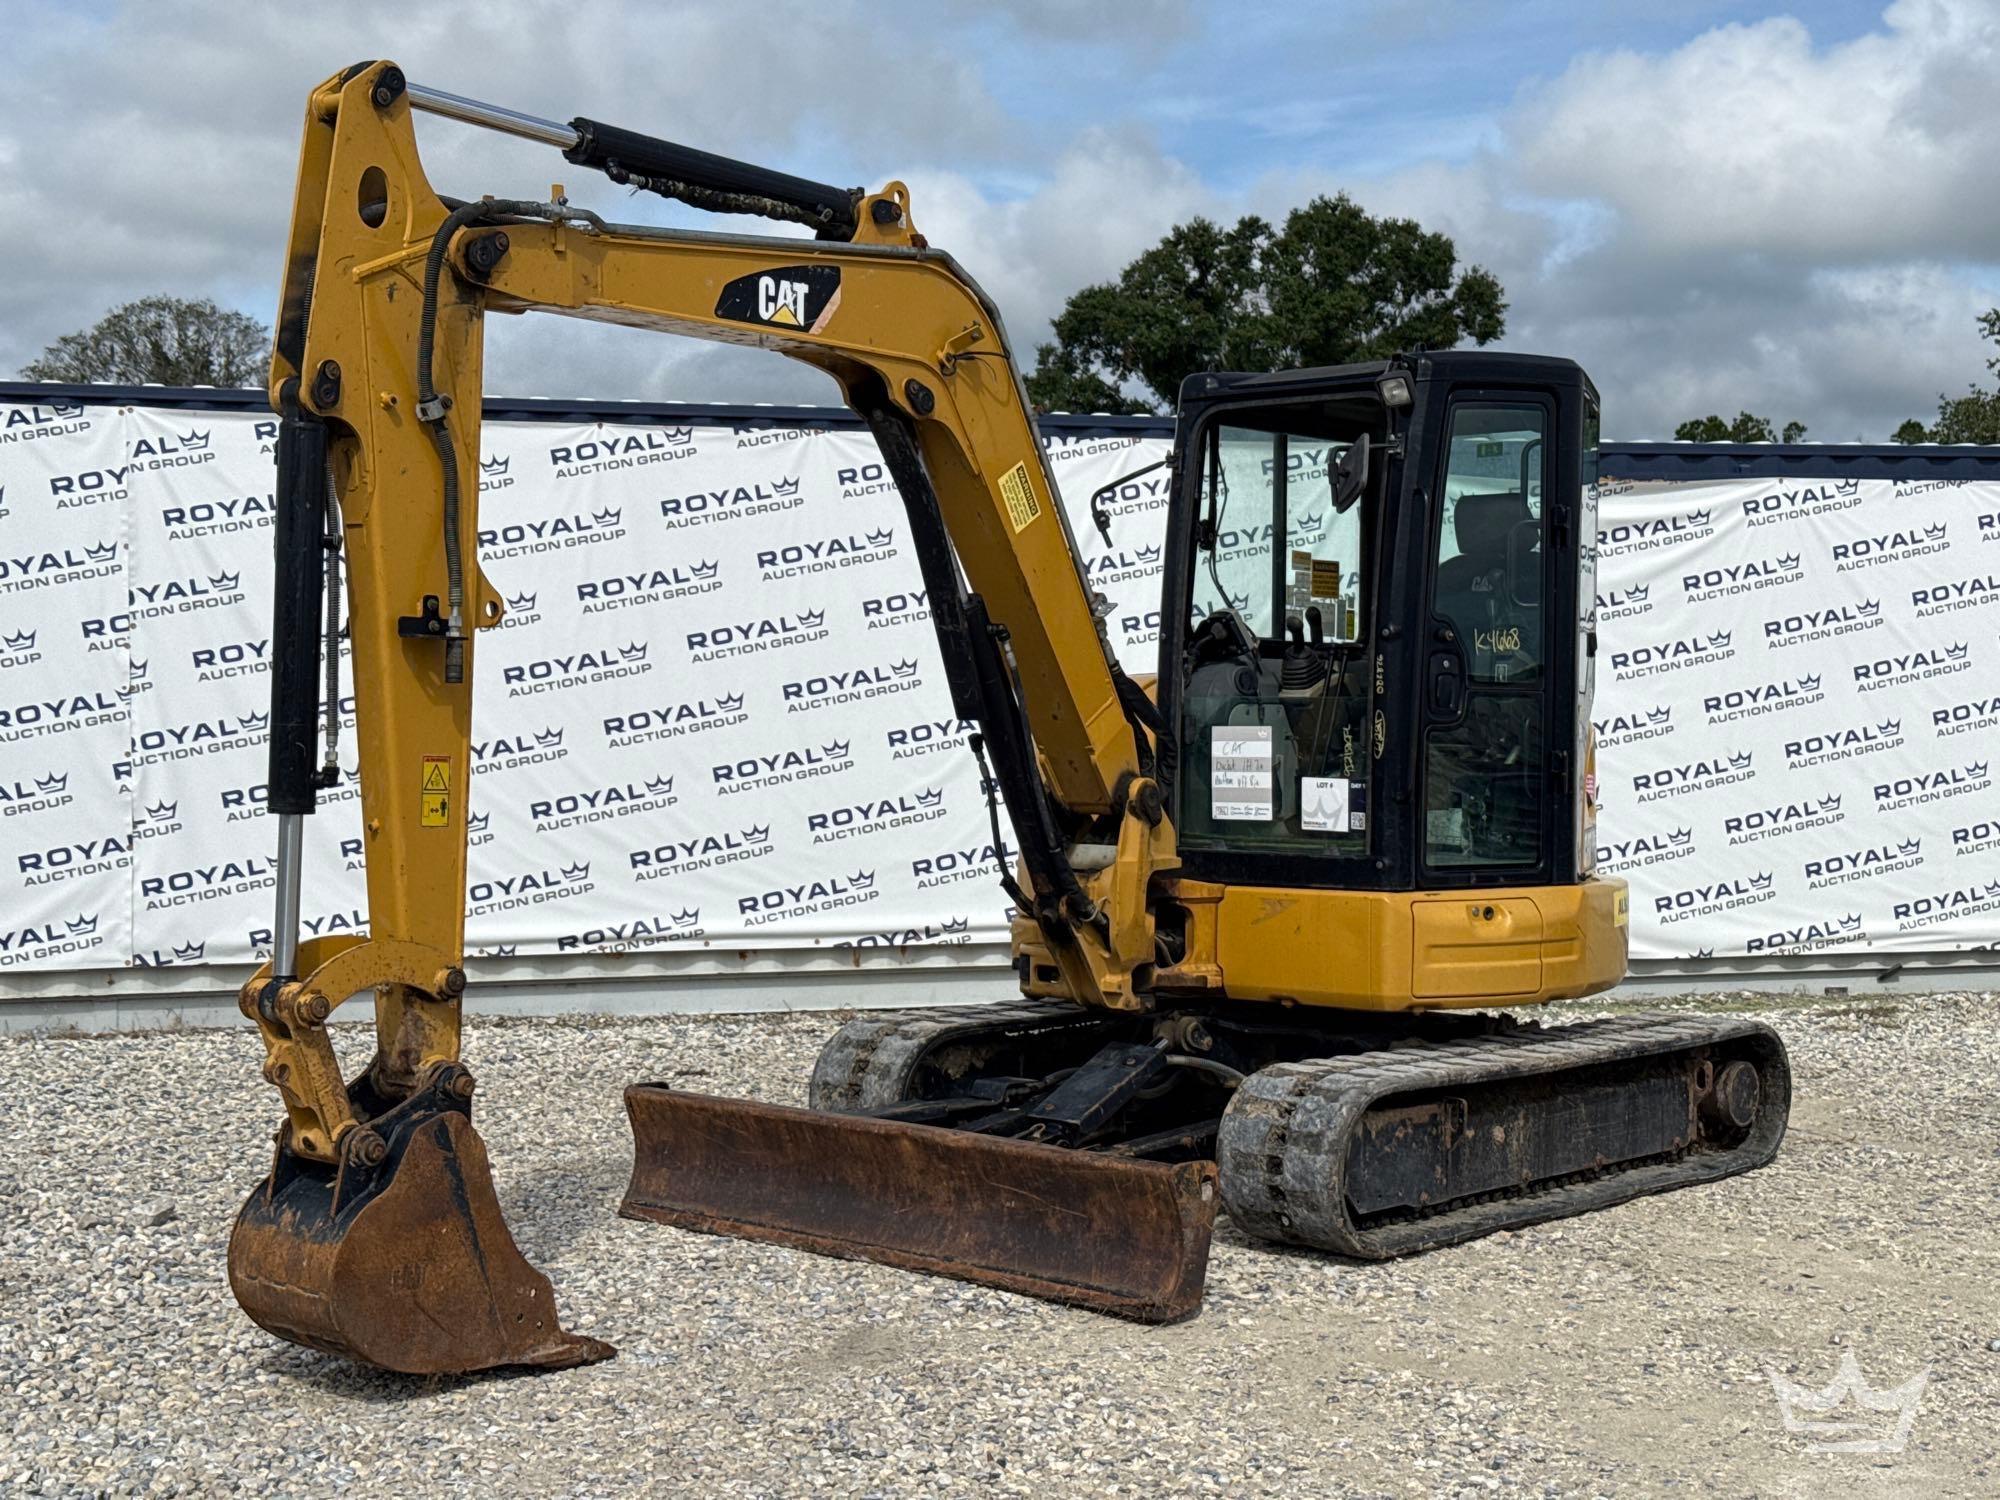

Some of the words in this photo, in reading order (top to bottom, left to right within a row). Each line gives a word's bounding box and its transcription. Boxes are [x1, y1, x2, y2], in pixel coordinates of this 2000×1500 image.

[758, 276, 808, 326] CAT
[22, 422, 90, 440] GROUP
[148, 453, 215, 470] GROUP
[550, 434, 664, 465] ROYAL
[556, 458, 633, 478] AUCTION
[637, 448, 697, 465] GROUP
[50, 466, 129, 495] ROY
[479, 478, 514, 492] OUP
[57, 490, 128, 509] AUCTIO
[661, 484, 772, 516] ROYAL
[666, 509, 741, 530] AUCTION
[745, 498, 804, 516] GROUP
[1742, 486, 1835, 516] ROYAL
[1748, 509, 1810, 528] AUCTION
[1812, 498, 1862, 514] GROUP
[169, 520, 253, 540] AUCTION
[478, 516, 593, 548] ROYAL
[482, 540, 560, 561] AUCTION
[564, 529, 625, 547] GROUP
[1663, 528, 1713, 545] GROUP
[1833, 530, 1924, 560] ROYAL
[757, 536, 866, 568] ROYAL
[763, 560, 836, 581] AUCTION
[840, 549, 897, 567] GROUP
[1082, 552, 1136, 574] YAL
[1837, 552, 1899, 572] AUCTION
[1902, 542, 1950, 558] GROUP
[54, 564, 122, 584] GROUP
[577, 568, 690, 601] ROYAL
[1683, 560, 1777, 592] ROYAL
[1688, 583, 1751, 603] AUCTION
[1754, 572, 1804, 589] GROUP
[583, 592, 659, 614] AUCTION
[663, 582, 722, 599] GROUP
[863, 591, 926, 617] ROY
[1912, 576, 2000, 606] ROYAL
[129, 605, 174, 620] TION
[179, 594, 245, 612] GROUP
[868, 611, 931, 630] AUCTIO
[1601, 604, 1652, 621] GROUP
[1764, 607, 1856, 637] ROYAL
[1916, 598, 1977, 618] AUCTION
[687, 617, 798, 650] ROYAL
[692, 642, 767, 663] AUCTION
[770, 630, 828, 648] GROUP
[1474, 628, 1520, 656] K4668
[1769, 629, 1830, 649] AUCTION
[1834, 618, 1884, 635] GROUP
[0, 653, 41, 668] OUP
[192, 640, 268, 668] ROY
[504, 650, 619, 684] ROYAL
[1611, 638, 1708, 670] ROYAL
[1616, 661, 1680, 681] AUCTION
[1684, 650, 1734, 667] GROUP
[1854, 650, 1945, 681] ROYAL
[198, 662, 272, 682] AUCTIO
[509, 675, 587, 698] AUCTION
[591, 664, 652, 682] GROUP
[782, 667, 891, 700] ROYAL
[1858, 672, 1920, 692] AUCTION
[1923, 661, 1971, 678] GROUP
[788, 691, 861, 713] AUCTION
[865, 680, 922, 698] GROUP
[1704, 682, 1798, 713] ROYAL
[1708, 704, 1772, 725] AUCTION
[1775, 693, 1824, 710] GROUP
[85, 710, 131, 726] GRO
[604, 701, 716, 735] ROYAL
[609, 726, 685, 748] AUCTION
[689, 714, 748, 732] GROUP
[888, 719, 976, 747] ROYA
[1593, 714, 1647, 736] YAL
[1937, 717, 1998, 737] AUCTION
[131, 720, 238, 753] OYAL
[470, 736, 534, 760] YAL
[893, 738, 964, 760] AUCTION
[1623, 726, 1674, 743] GROUP
[1785, 727, 1878, 758] ROYAL
[133, 746, 203, 767] UCTION
[506, 749, 568, 768] GROUP
[712, 748, 823, 783] ROYAL
[1789, 749, 1851, 770] AUCTION
[1855, 738, 1904, 755] GROUP
[718, 773, 792, 796] AUCTION
[796, 760, 854, 779] GROUP
[1633, 759, 1728, 791] ROYAL
[1638, 782, 1702, 803] AUCTION
[1705, 770, 1755, 788] GROUP
[1874, 769, 1966, 800] ROYAL
[4, 795, 73, 816] GROUP
[530, 784, 645, 820] ROYAL
[1878, 792, 1940, 812] AUCTION
[1943, 780, 1991, 797] GROUP
[536, 809, 614, 832] AUCTION
[618, 797, 678, 816] GROUP
[808, 797, 916, 832] ROYAL
[814, 821, 886, 844] AUCTION
[890, 809, 946, 827] GROUP
[1725, 802, 1818, 834] ROYAL
[1729, 824, 1792, 846] AUCTION
[1796, 813, 1844, 830] GROUP
[630, 834, 742, 869] ROYAL
[912, 842, 1018, 876] ROYAL
[1597, 834, 1668, 862] OYAL
[1597, 859, 1641, 874] CTION
[1644, 847, 1695, 864] GROUP
[1805, 846, 1897, 878] ROYAL
[24, 861, 112, 887] AUCTION
[141, 860, 266, 897] ROYAL
[636, 858, 711, 882] AUCTION
[715, 846, 774, 864] GROUP
[918, 866, 989, 889] AUCTION
[1809, 869, 1871, 890] AUCTION
[1875, 857, 1924, 874] GROUP
[146, 886, 232, 911] AUCTION
[236, 878, 276, 892] GRO
[465, 896, 529, 918] UCTION
[533, 883, 594, 903] GROUP
[470, 871, 561, 902] OYAL
[738, 879, 848, 914] ROYAL
[1655, 880, 1749, 913] ROYAL
[745, 904, 818, 926] AUCTION
[821, 891, 879, 910] GROUP
[1660, 903, 1722, 924] AUCTION
[1726, 891, 1776, 909] GROUP
[1894, 888, 1984, 920] ROYAL
[1900, 910, 1959, 931] AUCTION
[1962, 900, 2000, 916] GROU
[0, 924, 66, 951] YAL
[249, 910, 370, 947] RYAL
[558, 916, 672, 951] ROYAL
[642, 928, 704, 946] GROUP
[1747, 922, 1840, 952] ROYAL
[1815, 932, 1866, 949] GROUP
[34, 937, 103, 958] GROUP
